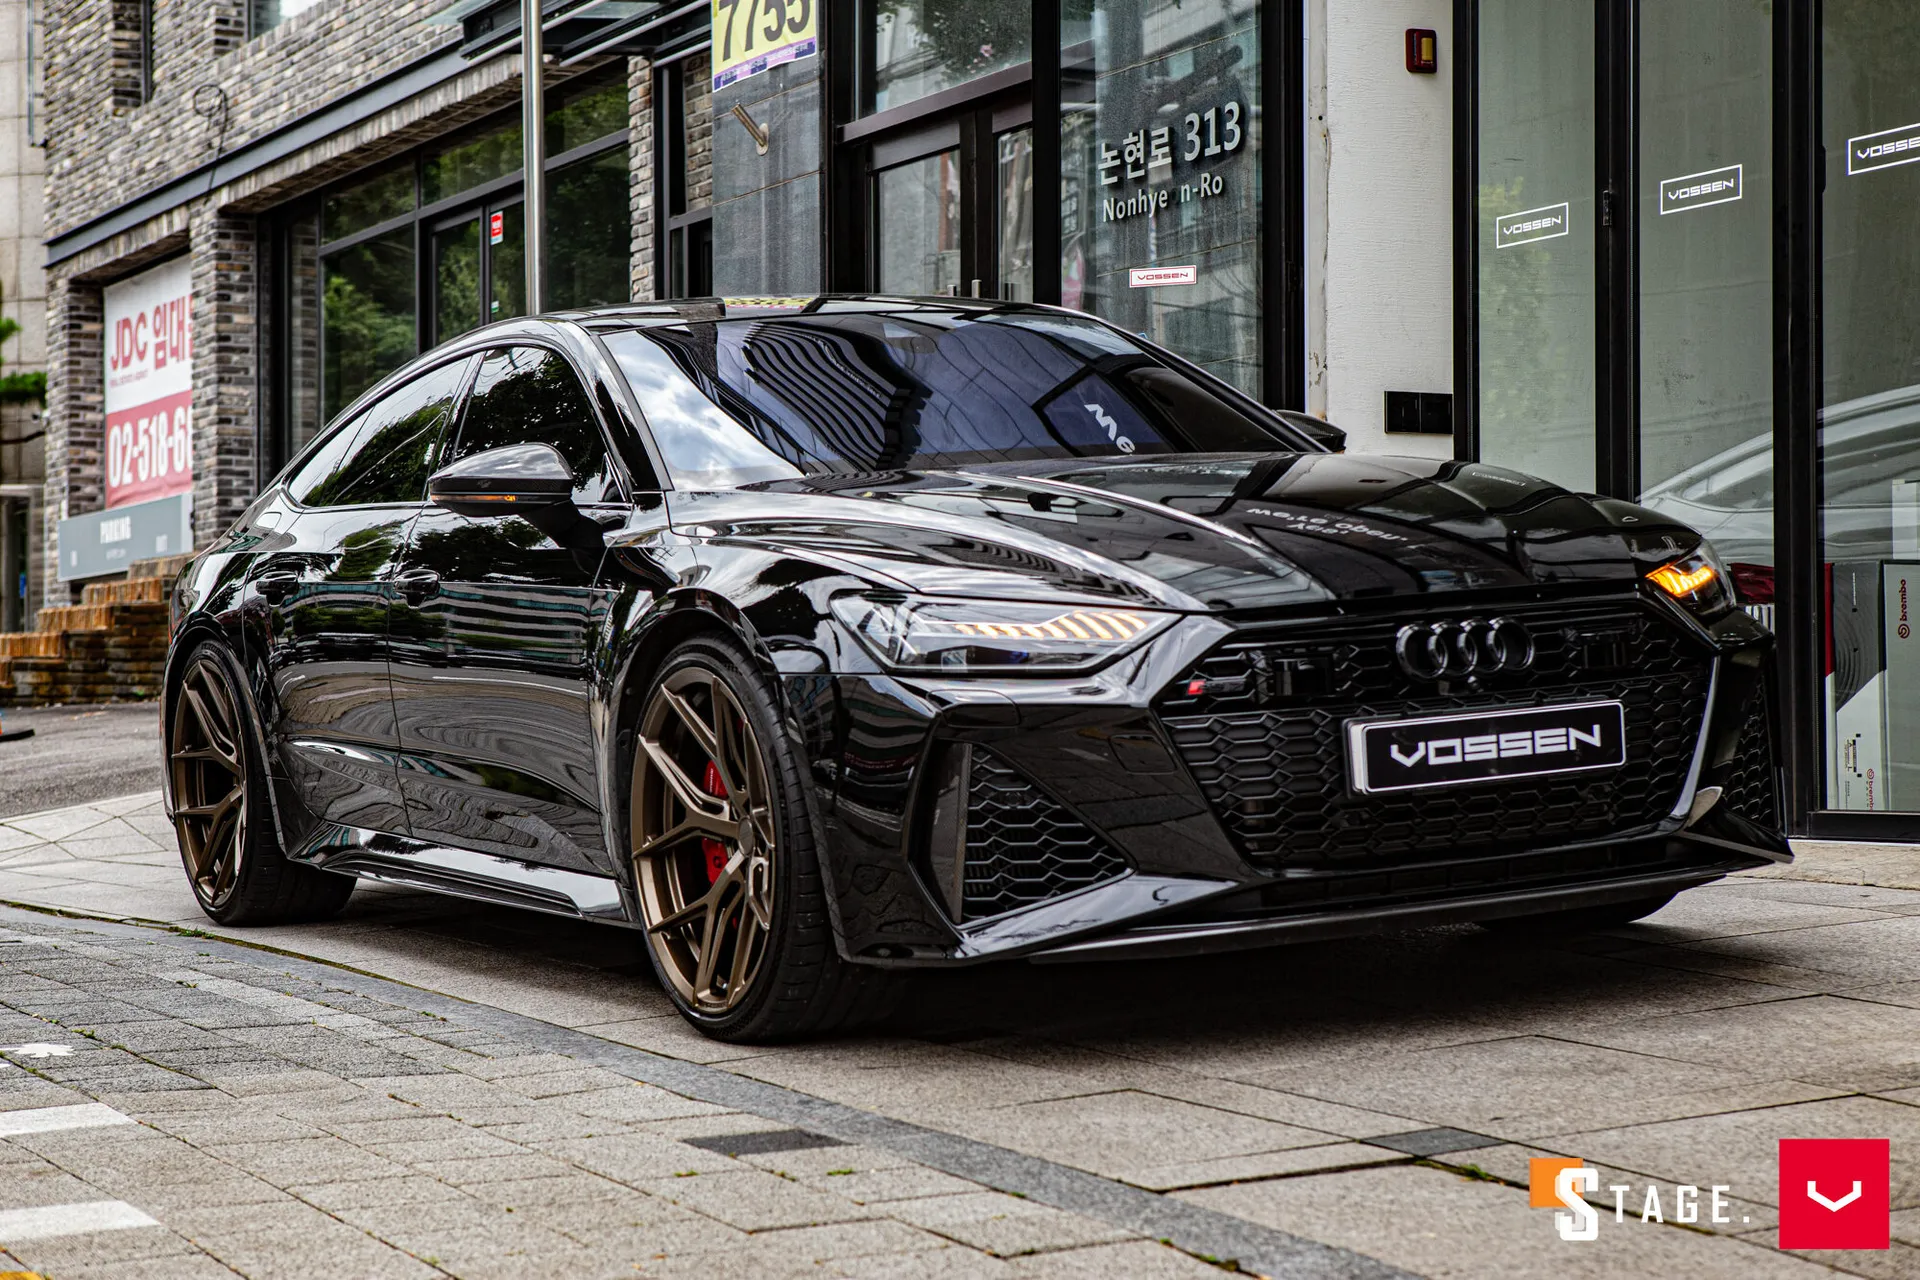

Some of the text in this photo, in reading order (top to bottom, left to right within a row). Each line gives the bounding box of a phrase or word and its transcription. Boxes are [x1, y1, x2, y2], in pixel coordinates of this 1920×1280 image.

[1098, 101, 1242, 186] 논현로 313
[1668, 178, 1734, 201] VOSSEN
[1503, 215, 1562, 235] VOSSEN
[1137, 272, 1189, 281] VOSSEN
[110, 312, 148, 371] JDC
[1899, 579, 1908, 621] brembo
[1390, 723, 1601, 768] VOSSEN
